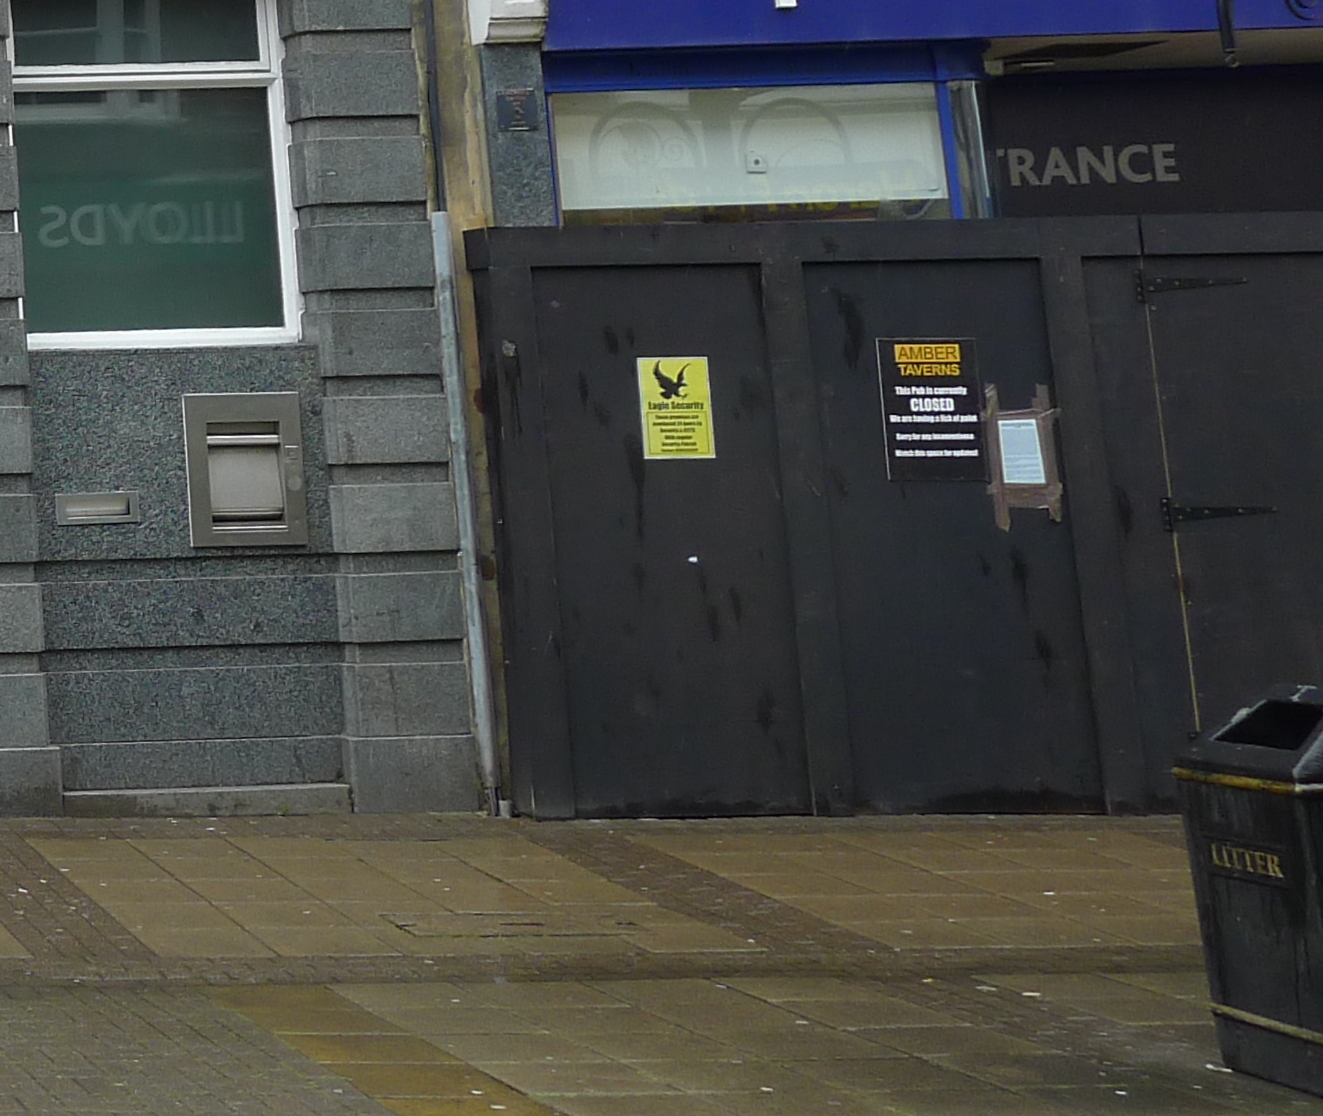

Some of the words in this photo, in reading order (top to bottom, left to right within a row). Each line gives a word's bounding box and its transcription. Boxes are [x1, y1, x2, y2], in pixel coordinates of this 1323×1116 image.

[897, 346, 958, 360] AMBER
[897, 364, 960, 376] TAVERNS
[671, 401, 704, 410] Security
[910, 397, 955, 412] CLOSED
[1211, 843, 1285, 878] LITTER
